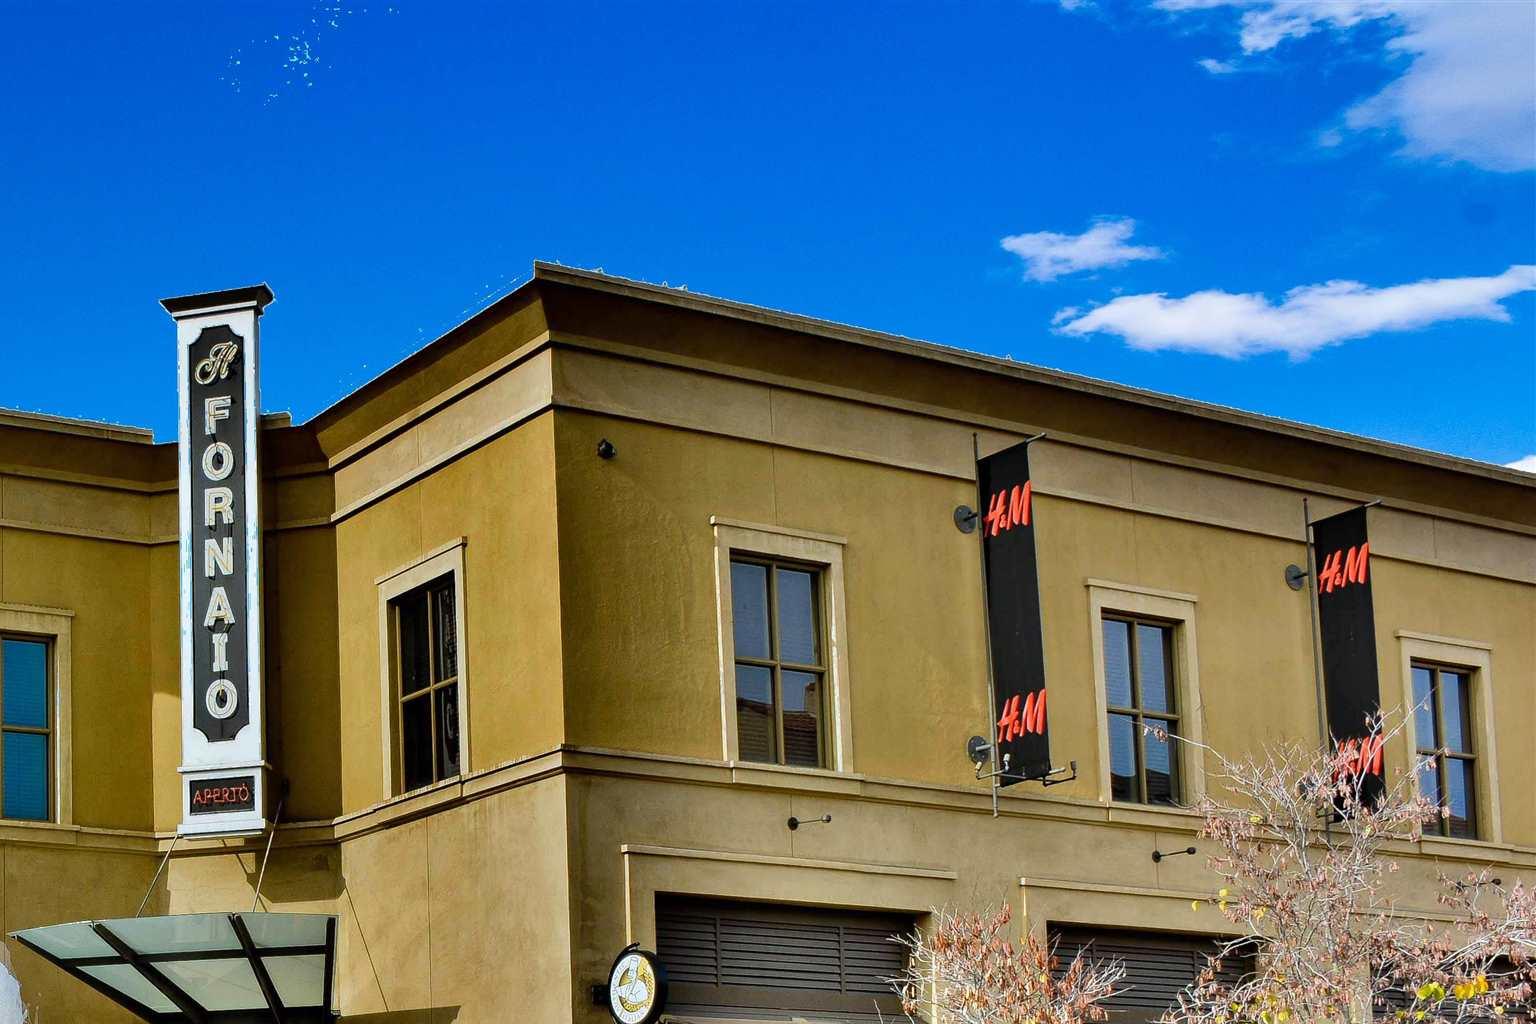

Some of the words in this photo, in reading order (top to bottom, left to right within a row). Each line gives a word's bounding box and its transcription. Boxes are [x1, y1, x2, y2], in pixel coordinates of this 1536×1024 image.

[982, 479, 1033, 538] H&M
[201, 395, 238, 719] FORNAIO
[1318, 541, 1370, 594] H&M
[997, 687, 1047, 743] H&M
